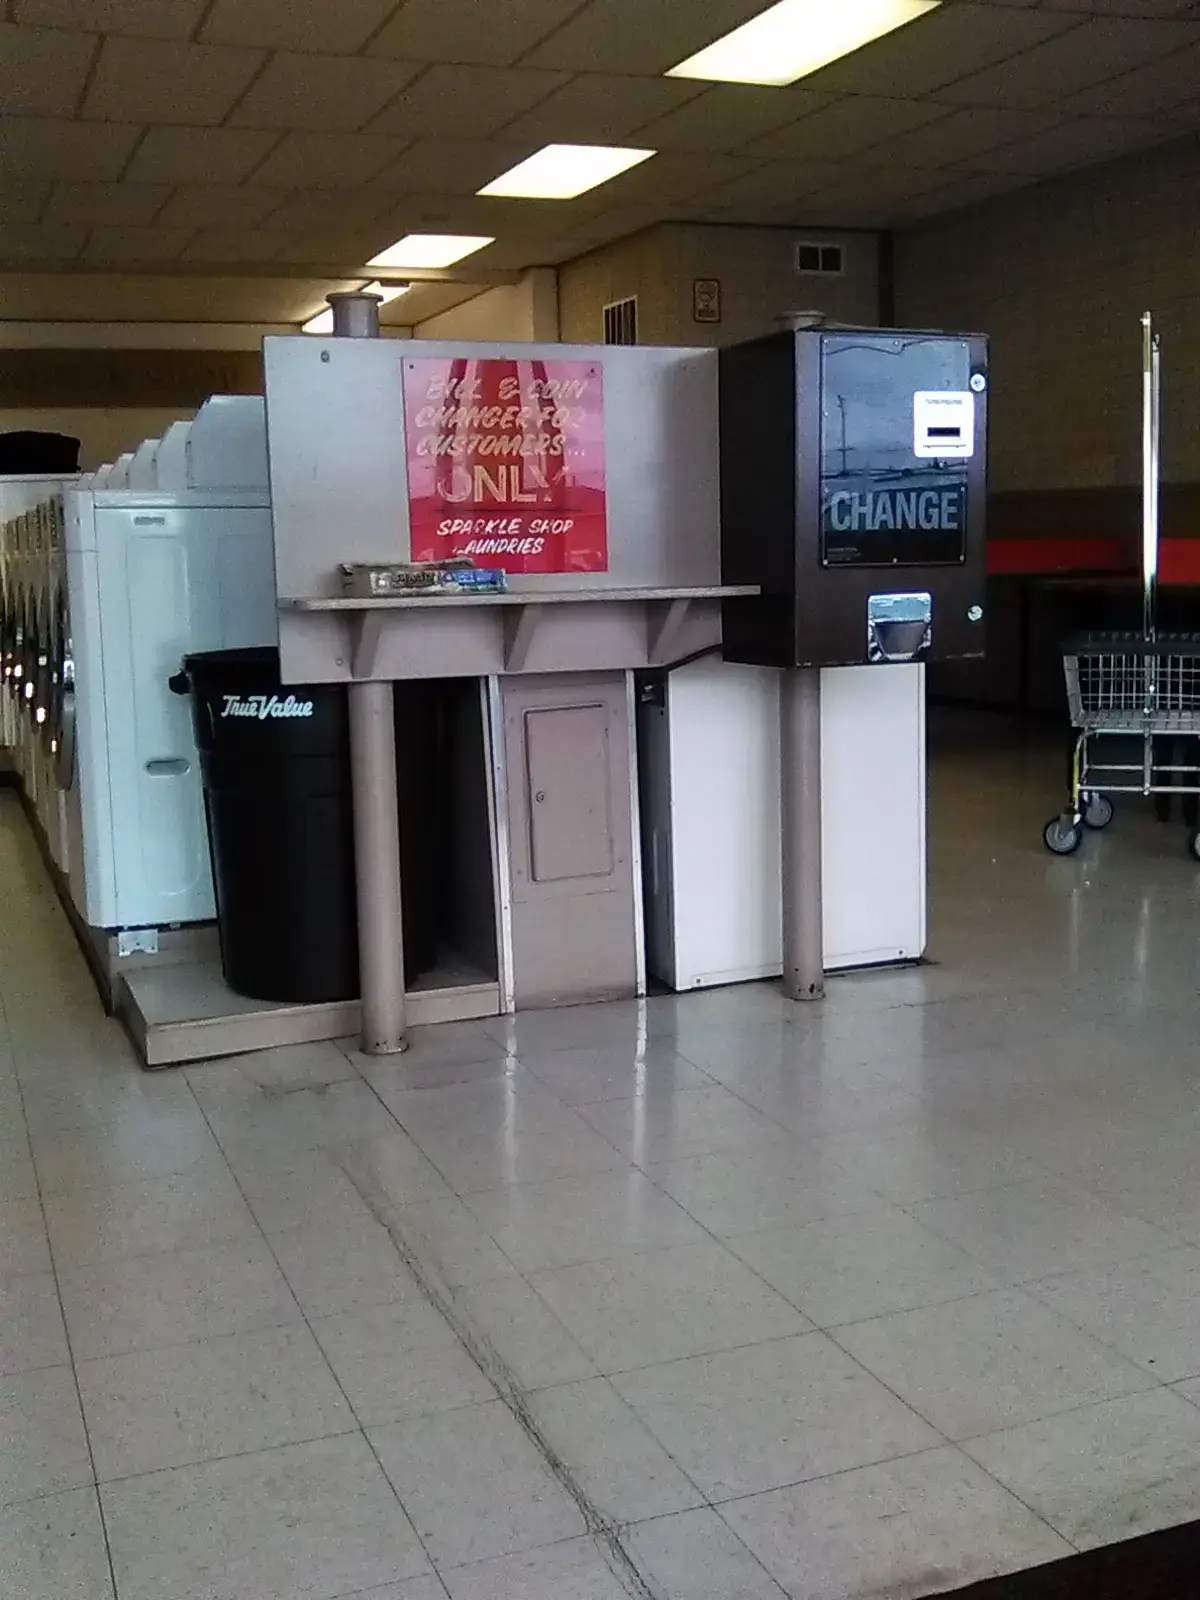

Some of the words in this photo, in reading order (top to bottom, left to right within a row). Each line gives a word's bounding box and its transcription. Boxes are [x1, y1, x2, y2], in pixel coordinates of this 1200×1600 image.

[528, 379, 588, 399] COIN
[831, 490, 959, 531] CHANGE
[436, 518, 523, 536] SPARKLE
[528, 518, 574, 534] SHOP
